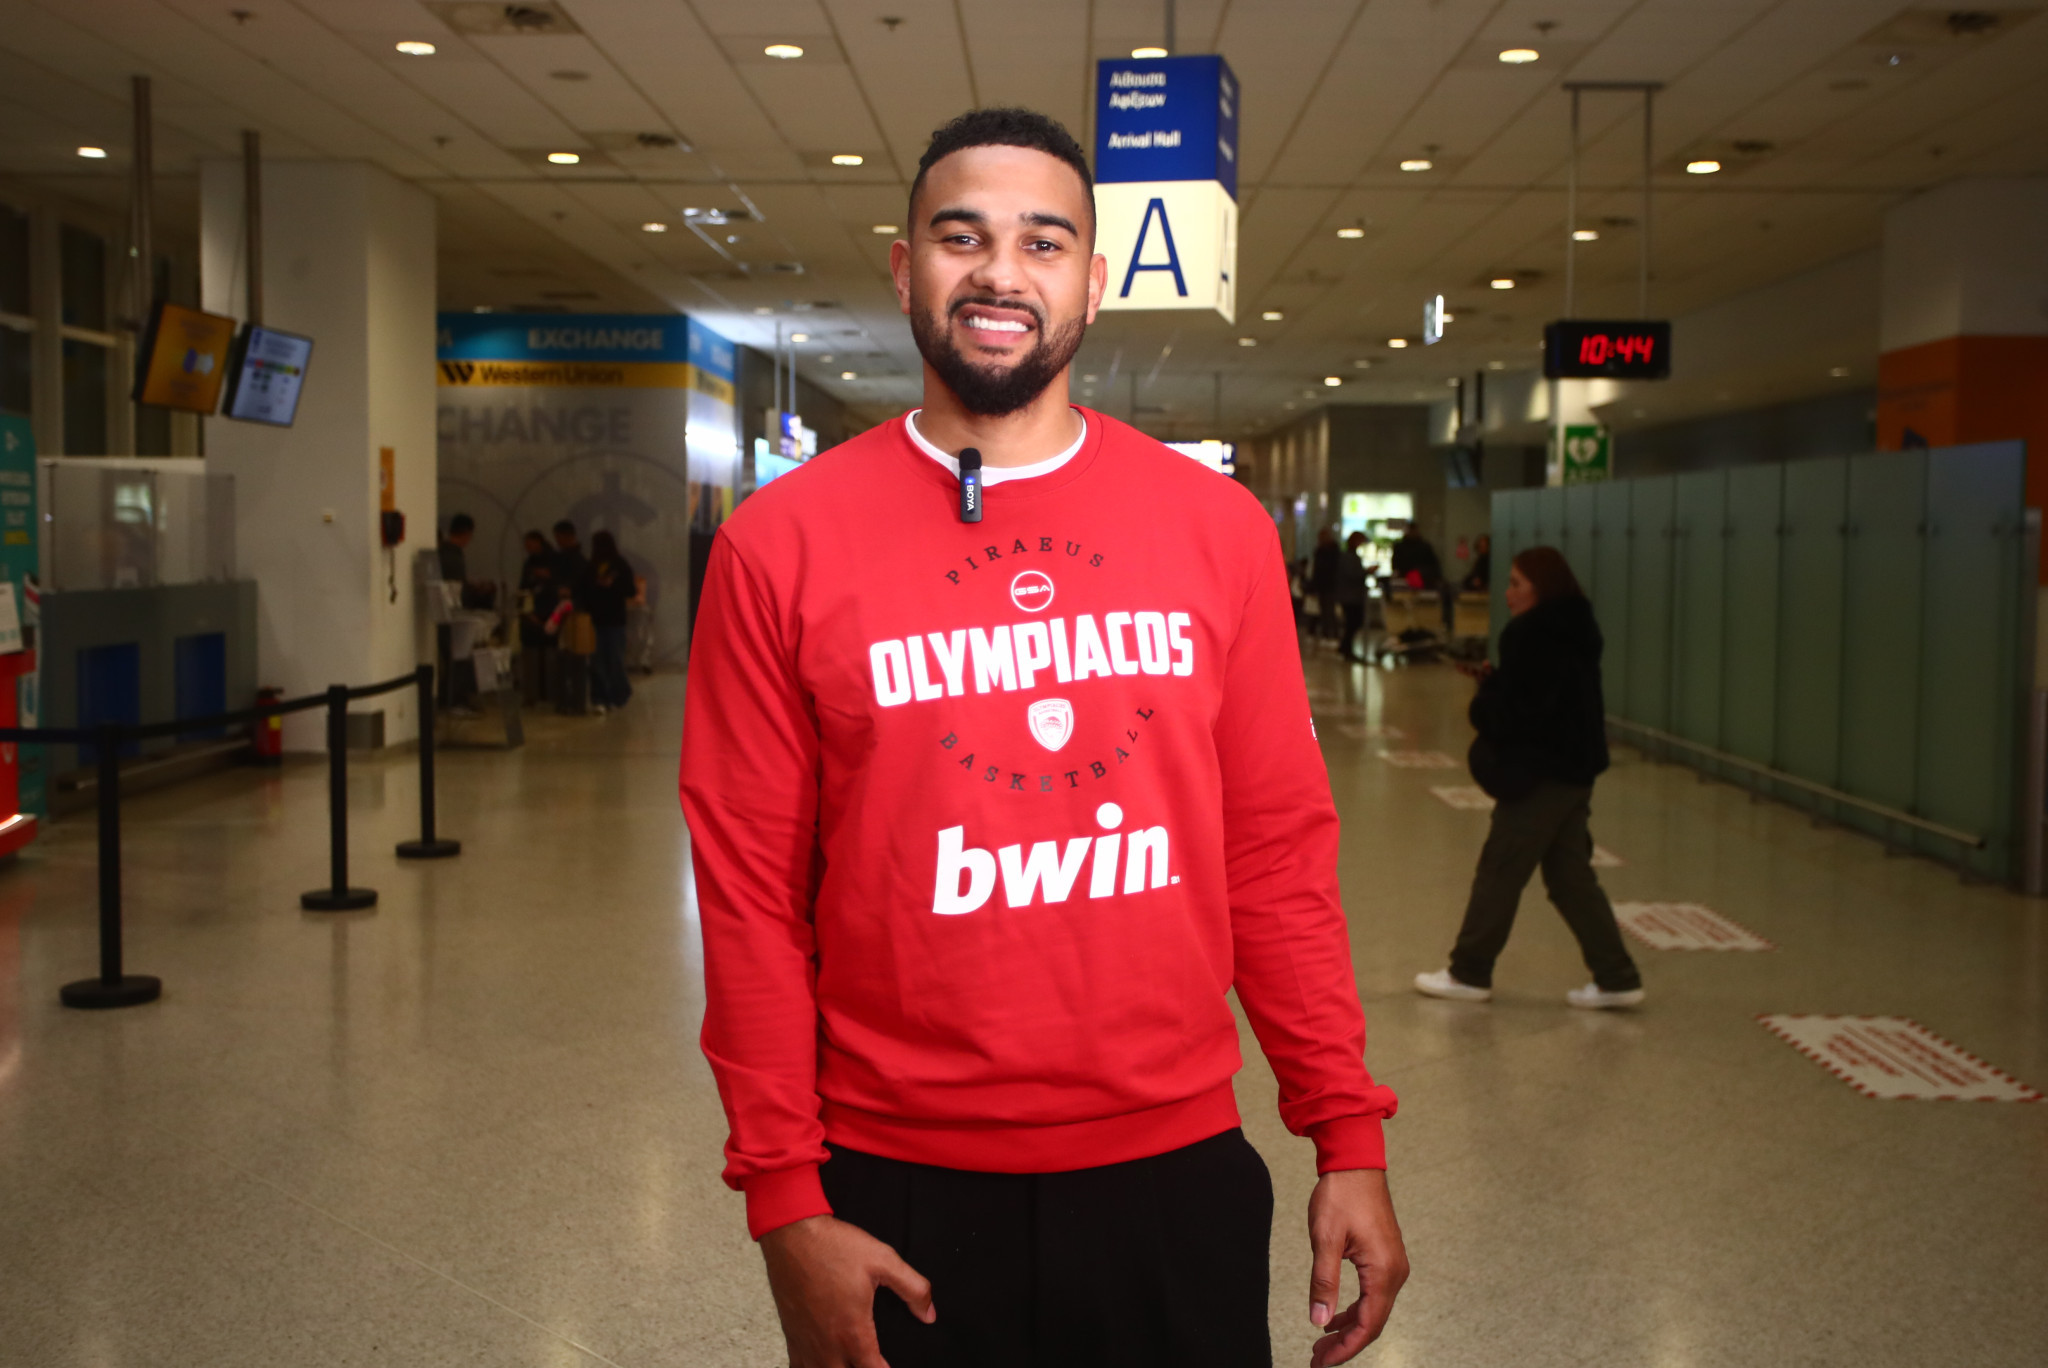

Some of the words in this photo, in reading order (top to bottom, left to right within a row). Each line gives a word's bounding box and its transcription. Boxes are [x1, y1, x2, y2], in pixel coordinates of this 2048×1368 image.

[1108, 132, 1152, 149] Arrival
[1153, 130, 1181, 147] Hall
[1119, 198, 1188, 298] A
[528, 328, 664, 350] EXCHANGE
[1580, 334, 1654, 365] 10:44
[480, 364, 562, 384] Western
[565, 364, 624, 385] Union
[966, 484, 975, 511] BOYA
[945, 537, 1104, 585] PIRAEUS
[1014, 585, 1050, 596] GSA
[870, 611, 1193, 707] OLYMPIACOS
[940, 707, 1154, 792] BASKETBALL
[932, 802, 1169, 916] bwin
